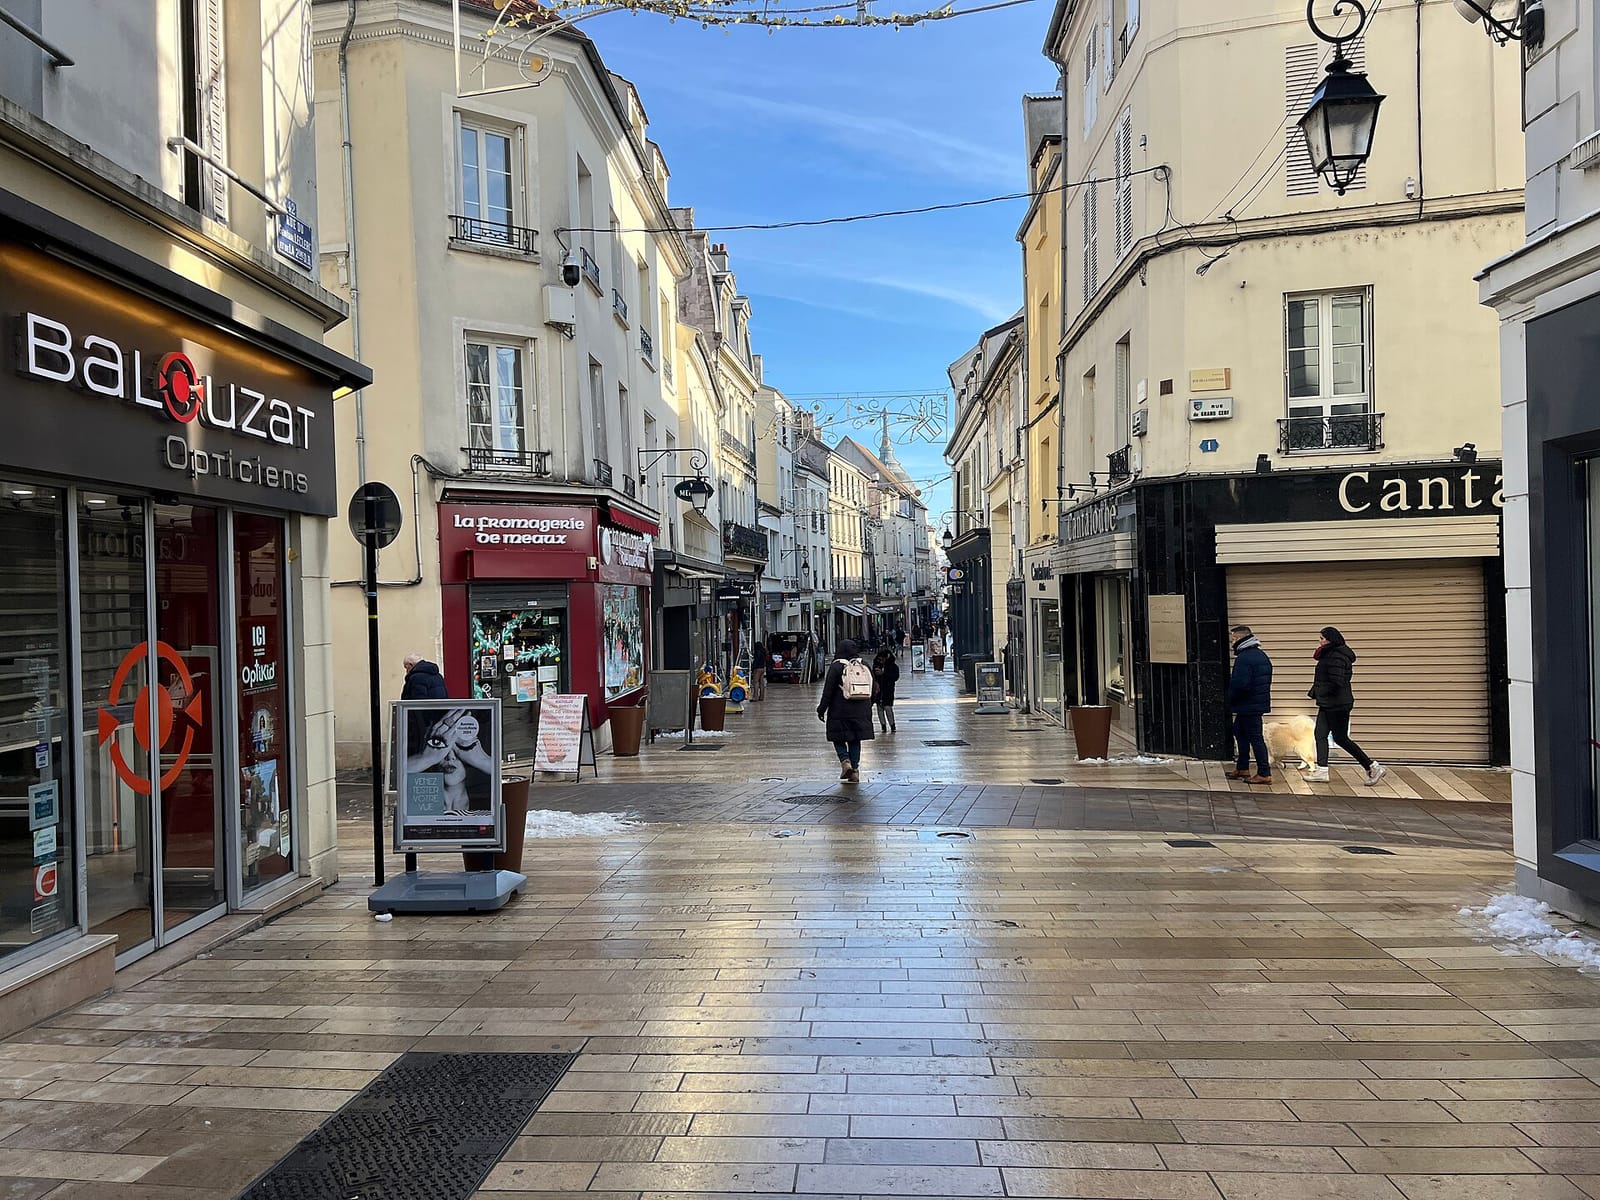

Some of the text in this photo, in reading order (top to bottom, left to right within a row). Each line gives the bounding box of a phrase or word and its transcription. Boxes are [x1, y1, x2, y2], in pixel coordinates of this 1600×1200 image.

[1207, 440, 1212, 451] 1
[252, 625, 266, 647] ICI
[414, 777, 438, 786] VENEZ
[413, 786, 439, 795] TESTER
[413, 795, 439, 803] VOTRE
